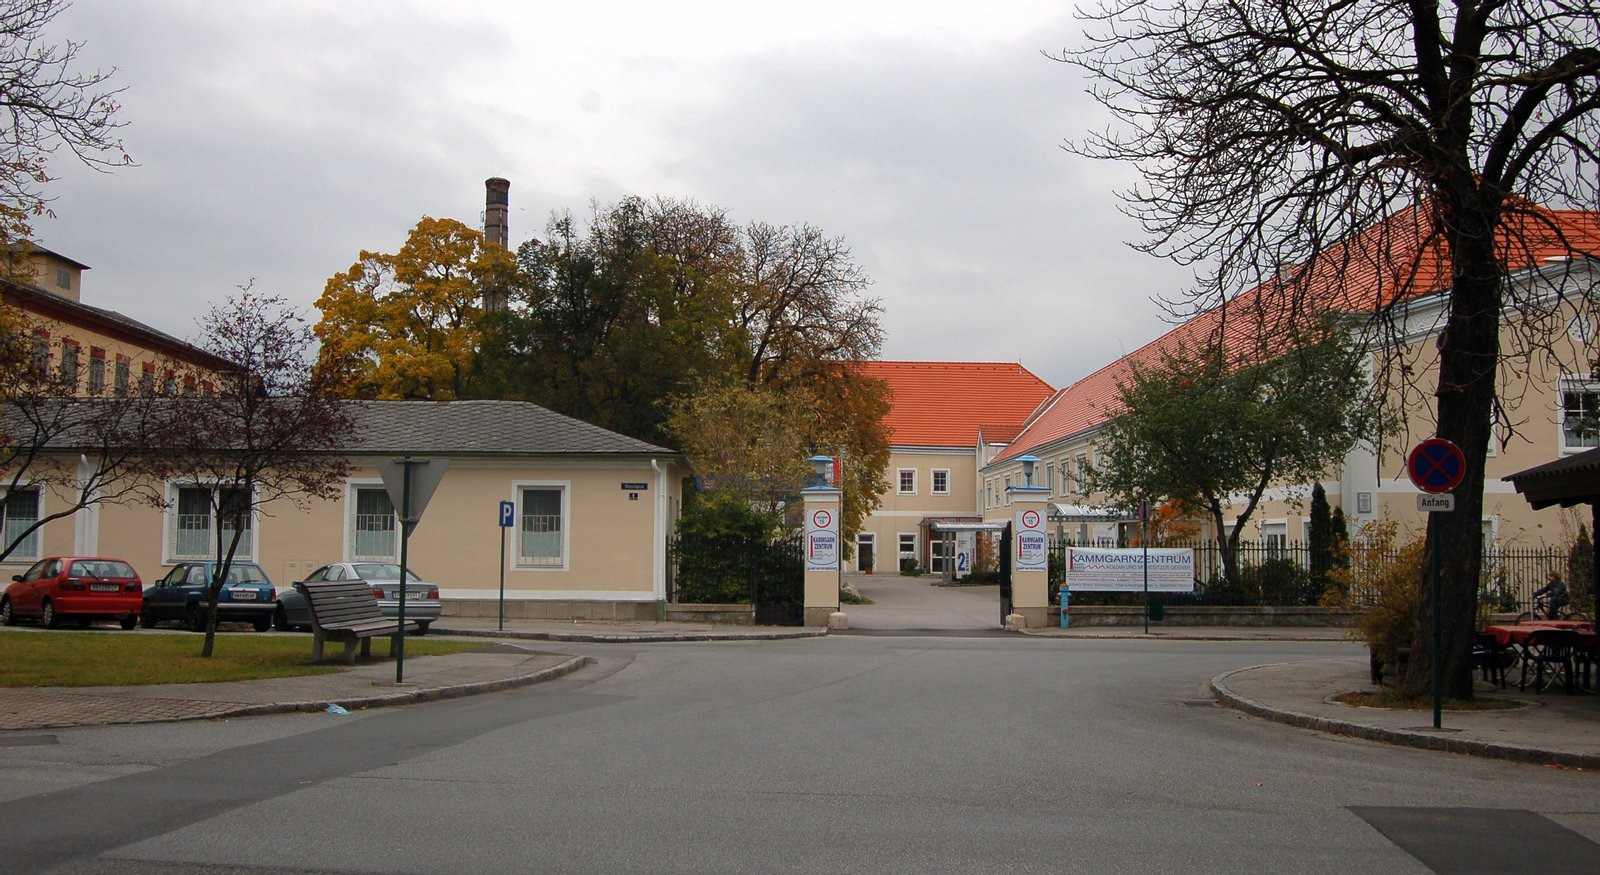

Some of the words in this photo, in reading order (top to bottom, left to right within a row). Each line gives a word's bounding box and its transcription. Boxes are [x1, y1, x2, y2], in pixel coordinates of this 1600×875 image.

[1421, 498, 1449, 508] Anfang
[503, 504, 512, 524] P
[958, 552, 965, 571] 2
[1070, 554, 1191, 564] KAMMGARNZENTRUM
